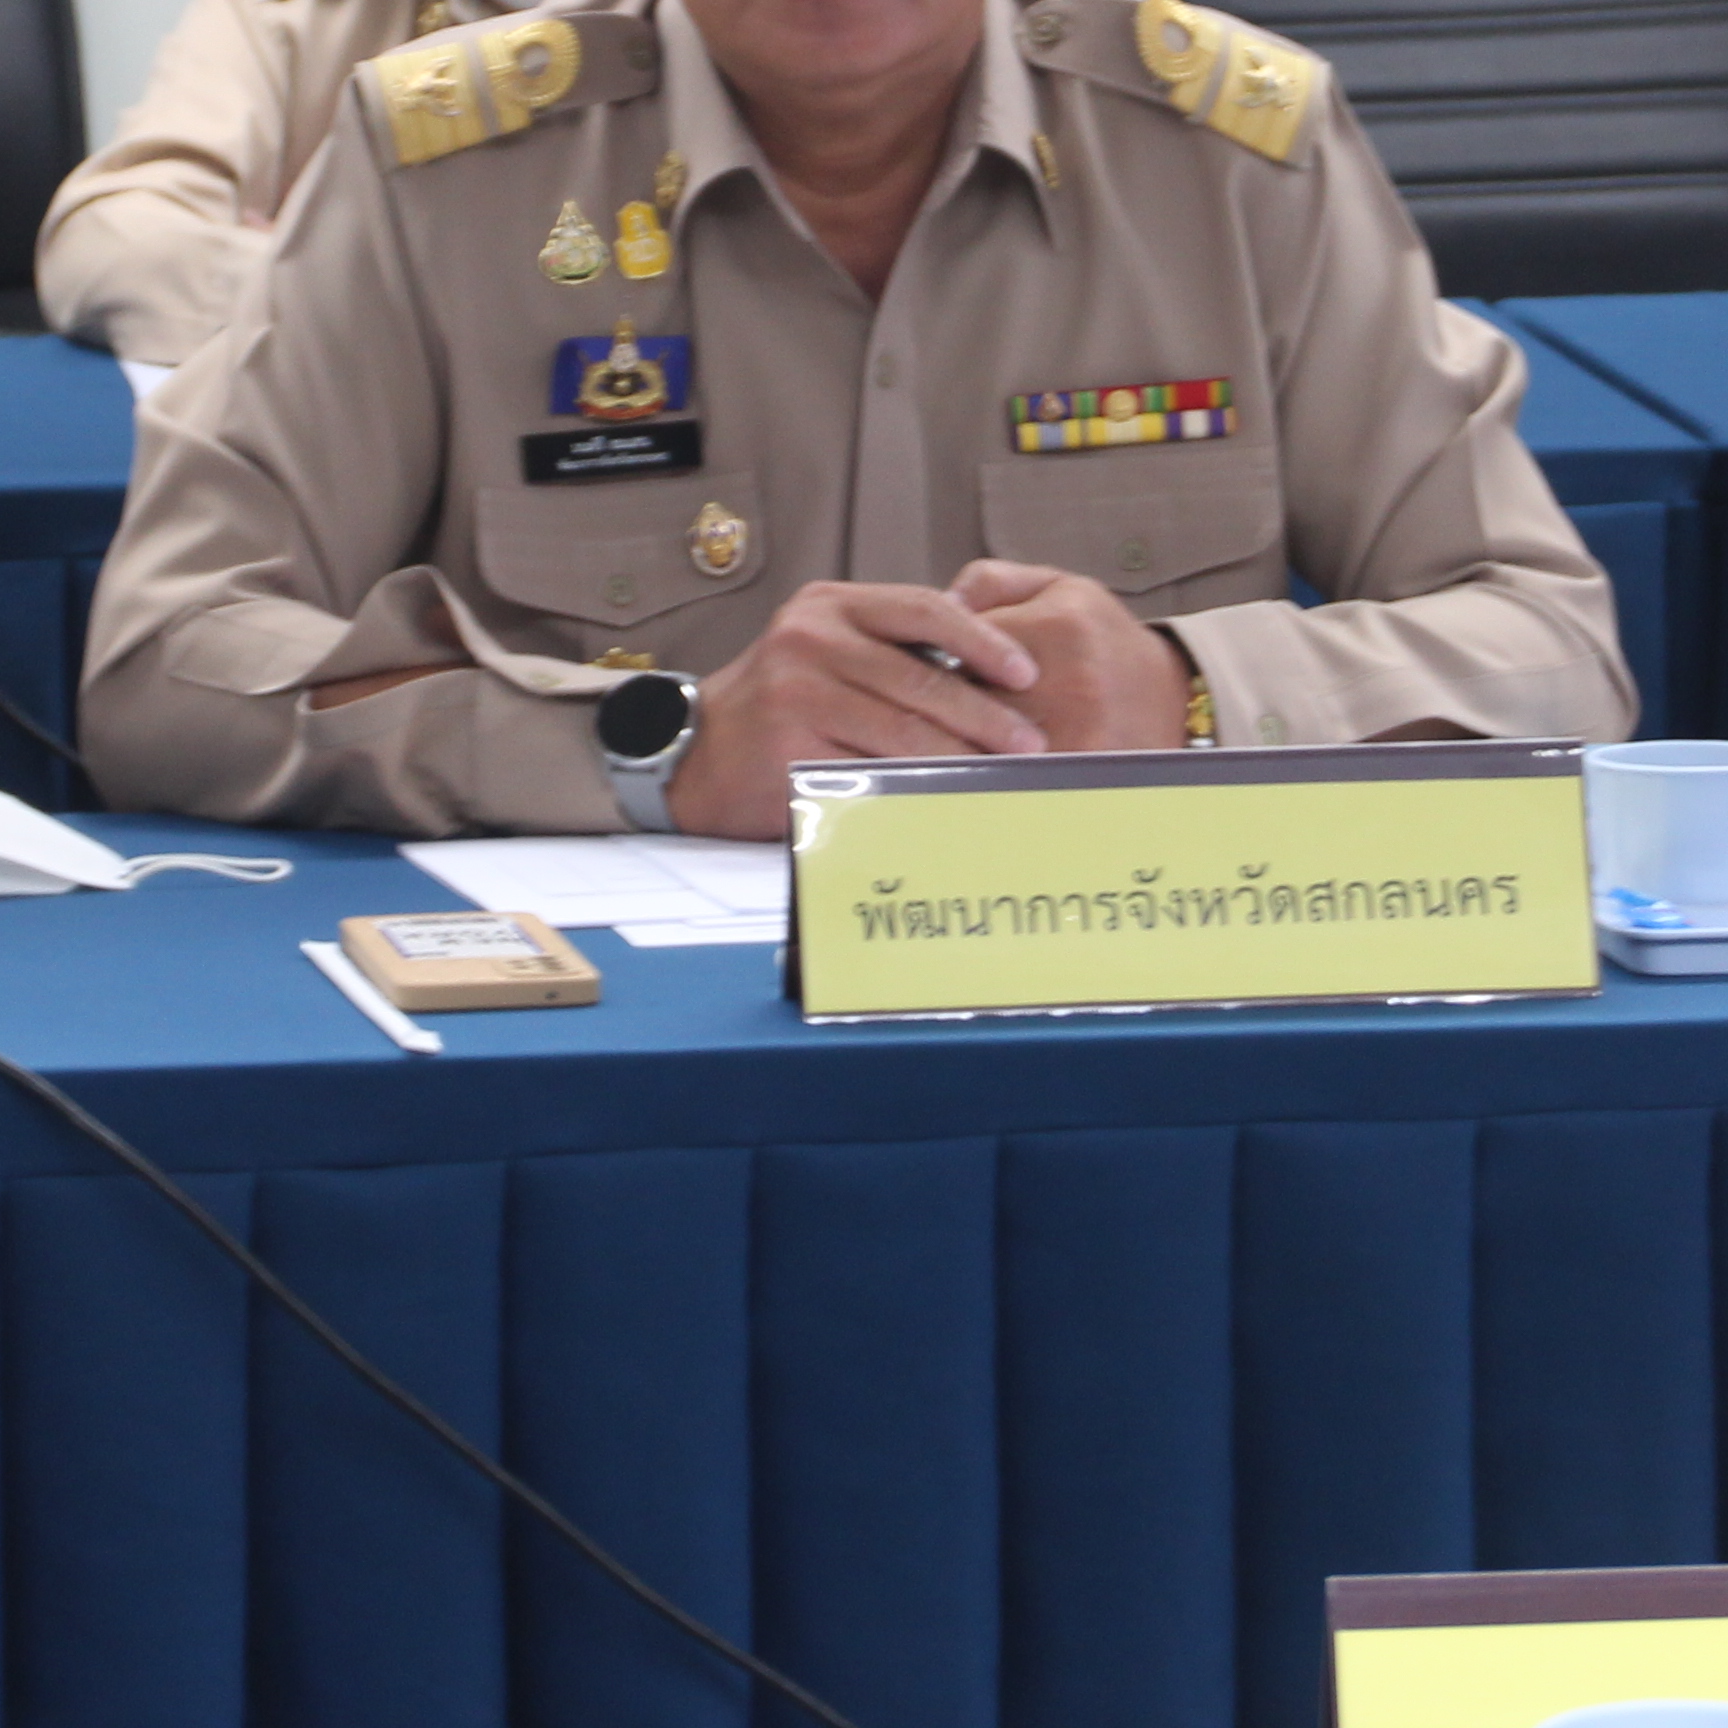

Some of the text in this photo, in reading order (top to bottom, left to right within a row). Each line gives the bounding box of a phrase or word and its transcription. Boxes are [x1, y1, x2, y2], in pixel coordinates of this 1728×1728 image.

[852, 863, 1521, 941] พัฒนาการจังหวัดสกลนคร
